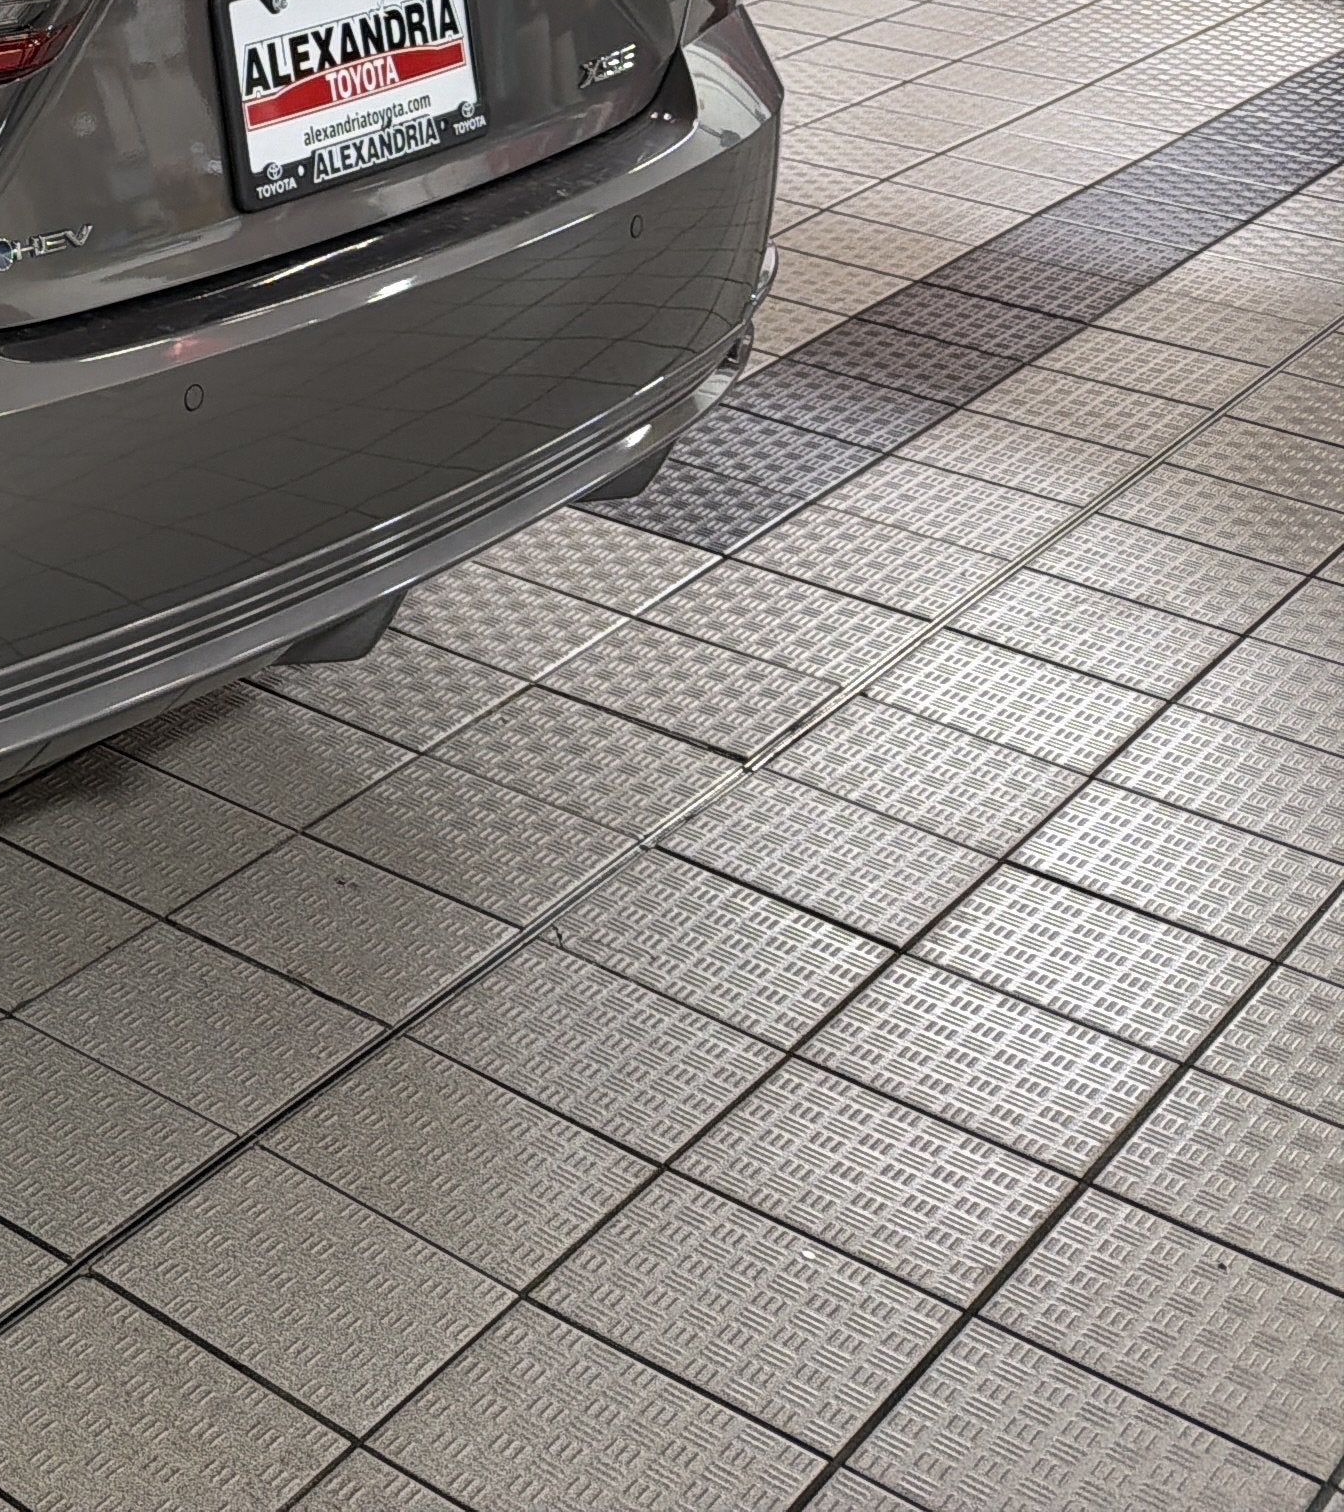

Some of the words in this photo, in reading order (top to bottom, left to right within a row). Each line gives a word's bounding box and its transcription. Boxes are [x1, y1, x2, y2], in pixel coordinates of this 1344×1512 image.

[325, 54, 400, 103] TOYOTA
[579, 42, 637, 90] XSE
[303, 93, 431, 146] alexandriatoyota.com
[452, 116, 487, 137] TOYOTA
[313, 117, 441, 184] ALEXANDRIA
[256, 176, 298, 200] TOYOTA
[12, 223, 94, 262] HEV
